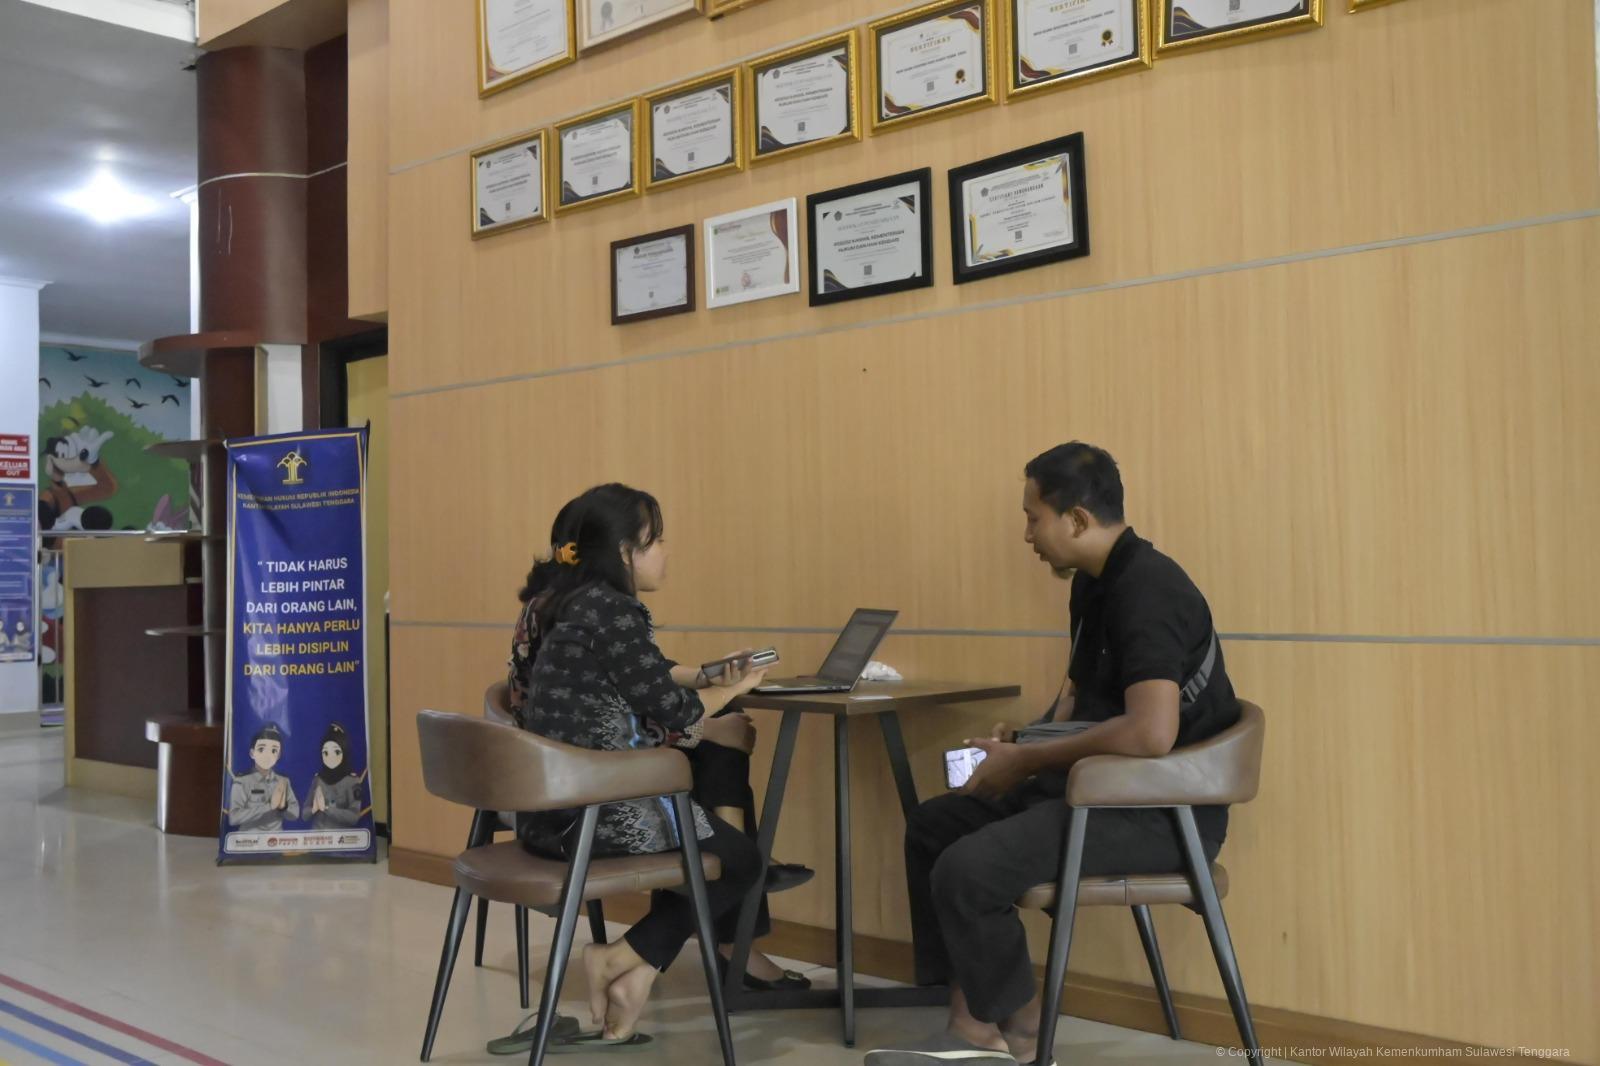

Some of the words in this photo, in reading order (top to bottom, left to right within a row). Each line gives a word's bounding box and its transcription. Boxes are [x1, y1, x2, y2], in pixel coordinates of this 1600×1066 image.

[266, 561, 306, 573] TIDAK
[308, 557, 348, 571] HARUS
[261, 582, 299, 594] LEBIH
[302, 578, 345, 592] PINTAR
[246, 601, 278, 614] DARI
[281, 601, 325, 614] ORANG
[328, 598, 357, 611] LAIN,
[243, 622, 273, 635] KITA
[277, 622, 321, 635] HANYA
[324, 619, 360, 632] PERLU
[256, 643, 295, 656] LEBIH
[298, 640, 349, 655] DISIPLIN
[244, 664, 276, 676] DARI
[279, 662, 324, 676] ORANG
[327, 661, 360, 674] LAIN"
